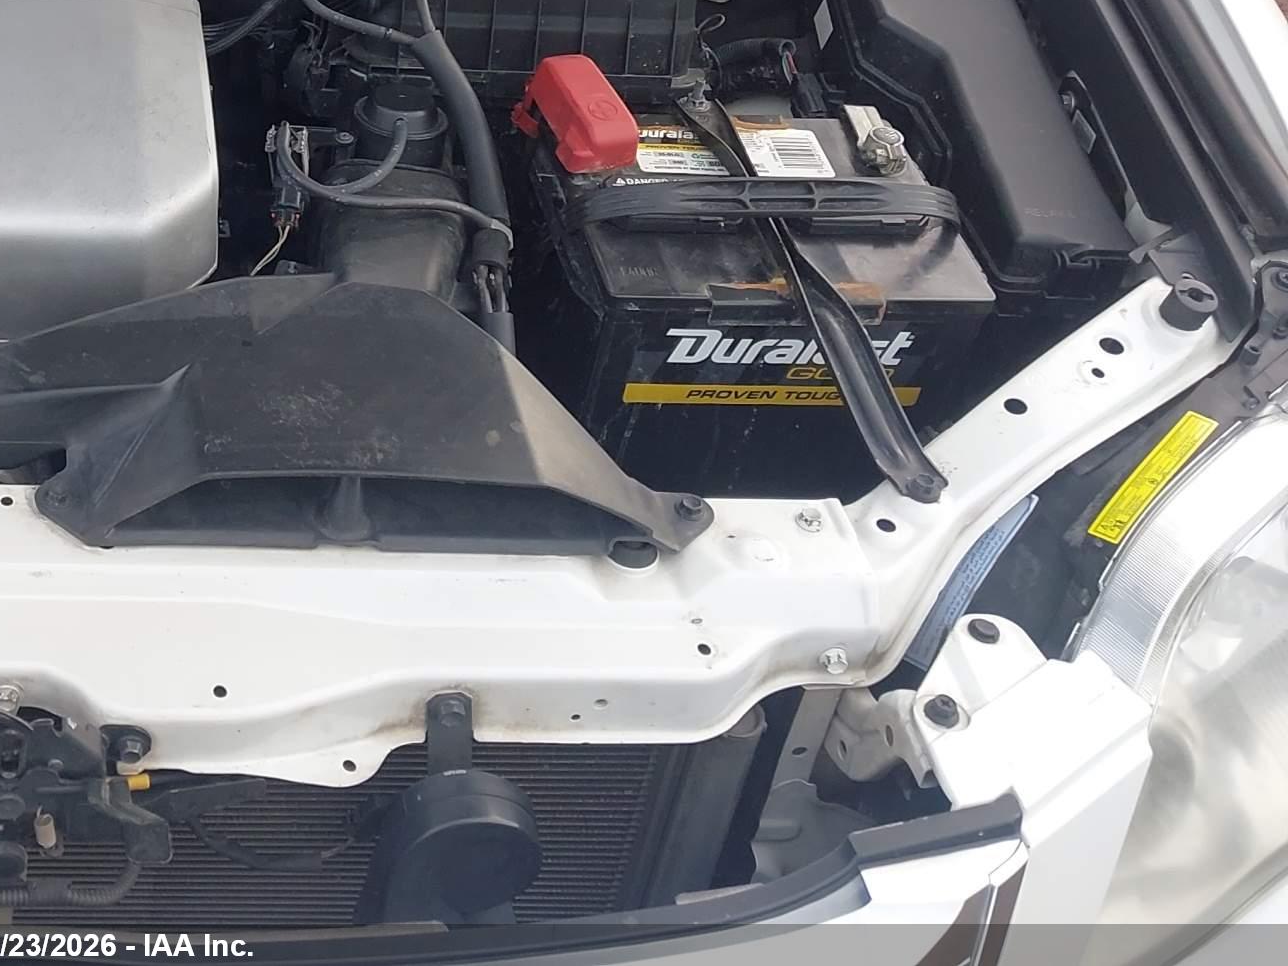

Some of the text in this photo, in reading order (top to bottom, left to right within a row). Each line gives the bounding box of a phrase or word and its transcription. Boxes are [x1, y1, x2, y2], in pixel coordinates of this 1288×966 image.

[666, 328, 914, 366] Duralst
[786, 367, 894, 380] GO
[685, 390, 841, 401] PROVEN TOUG
